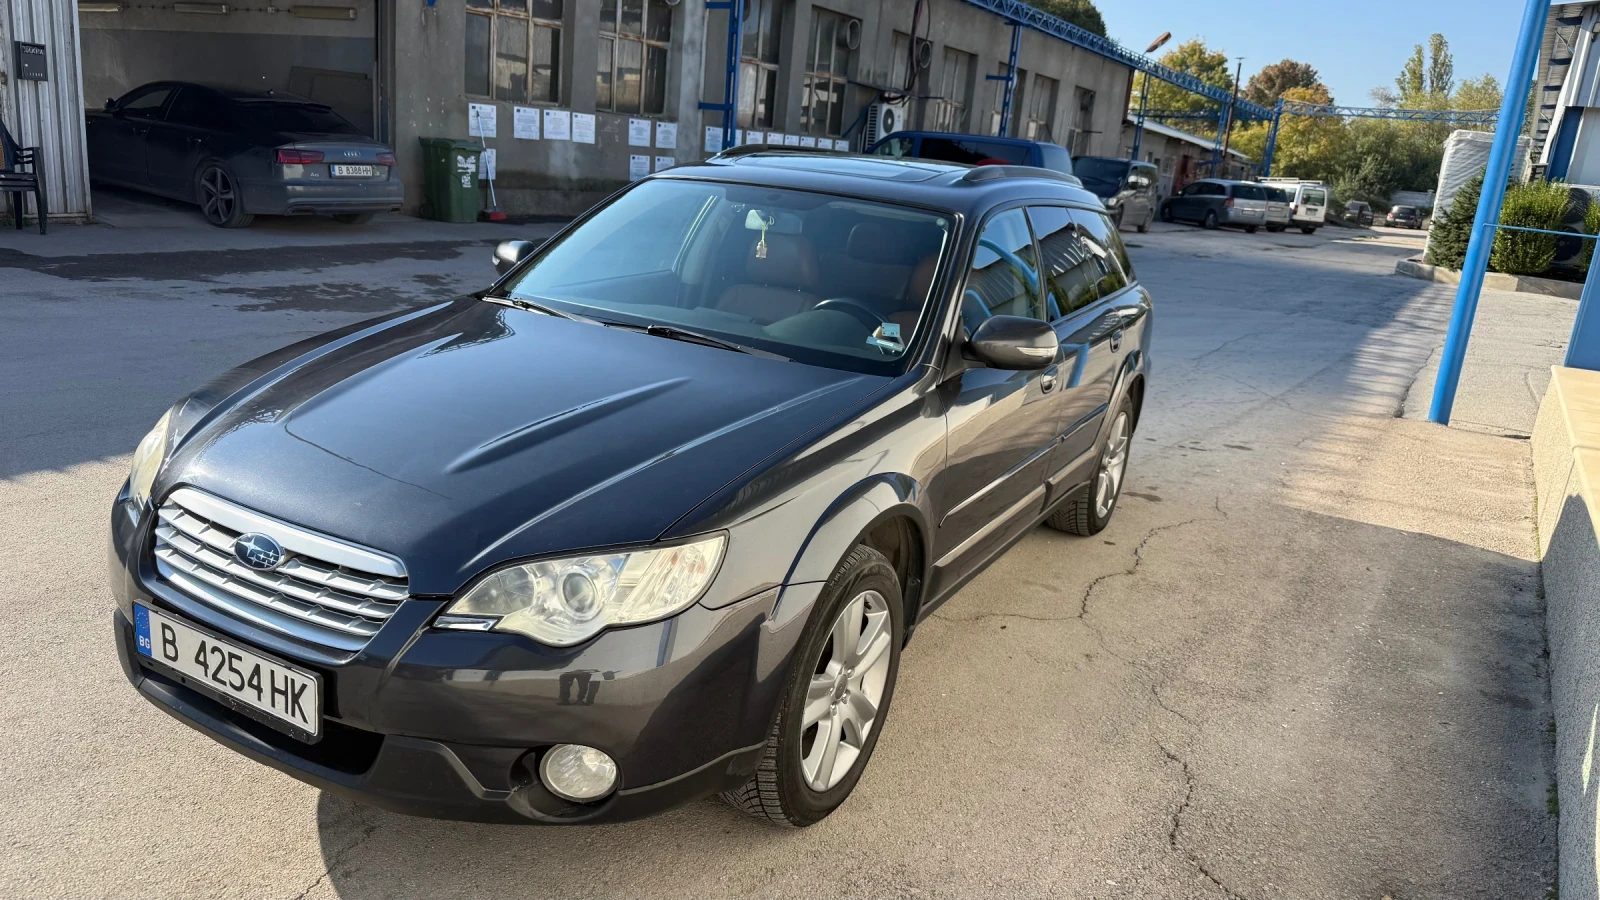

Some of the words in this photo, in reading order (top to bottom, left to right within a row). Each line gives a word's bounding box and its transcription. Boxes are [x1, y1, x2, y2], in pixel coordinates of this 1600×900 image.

[338, 166, 343, 175] B
[139, 635, 151, 649] BG
[161, 621, 179, 663] B
